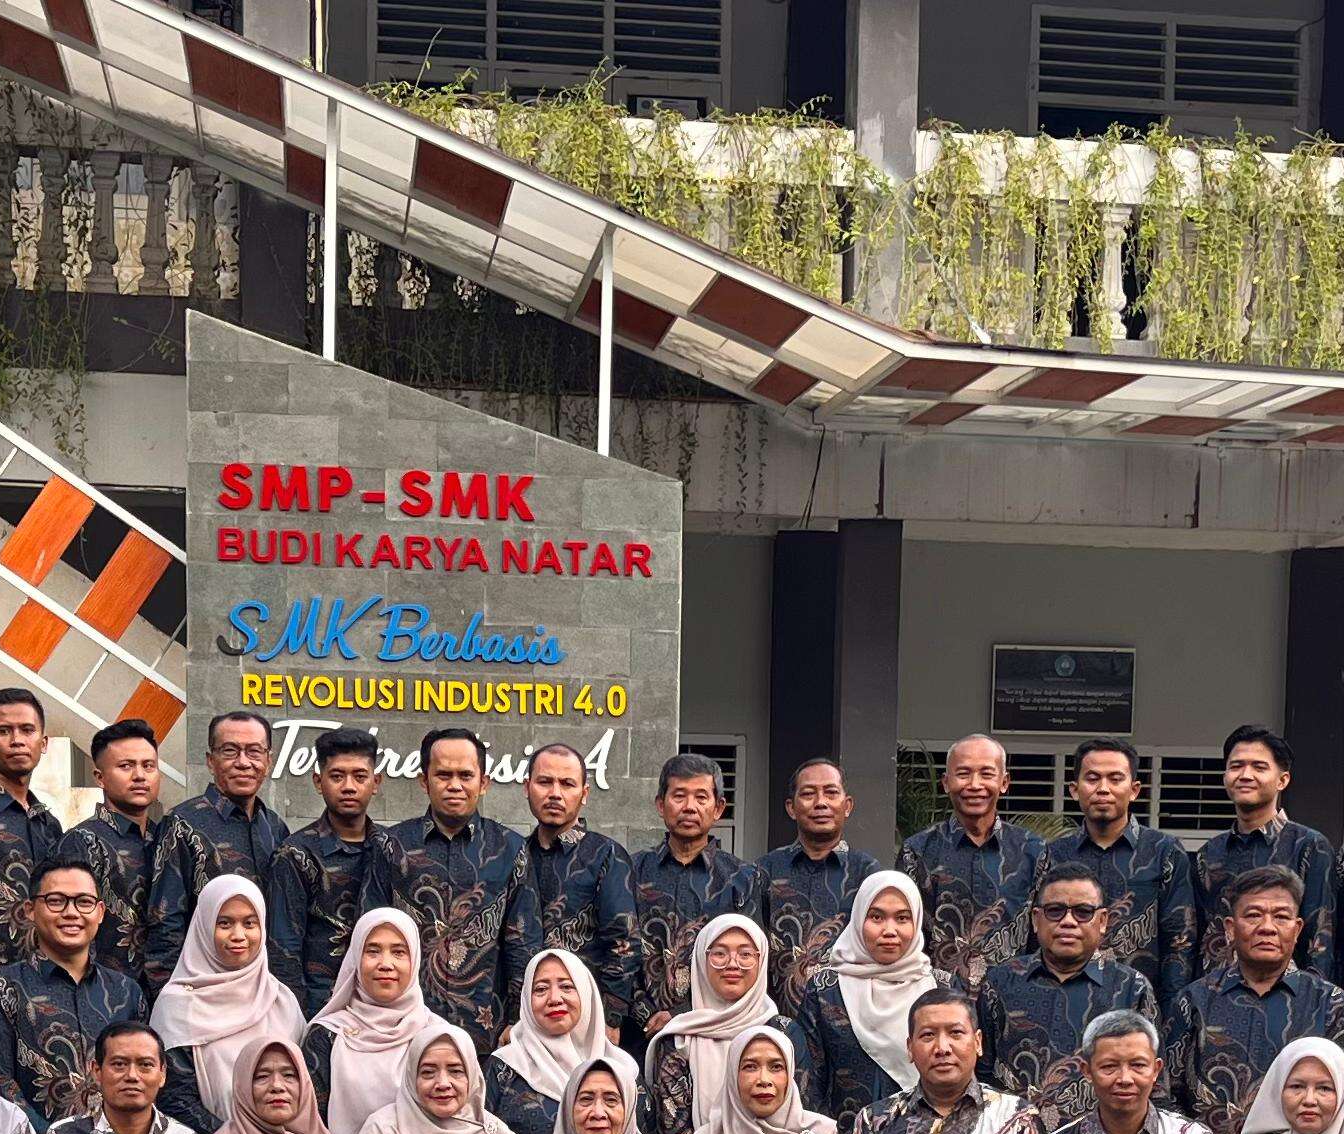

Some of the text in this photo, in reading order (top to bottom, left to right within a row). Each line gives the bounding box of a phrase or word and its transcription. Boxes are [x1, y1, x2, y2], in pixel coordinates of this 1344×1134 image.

[217, 527, 653, 578] BUDI KARYA NATAR
[216, 594, 567, 665] SMK Berbasis
[242, 672, 629, 718] REVOLUSI INDUSTRI 4.0
[583, 727, 616, 791] A
